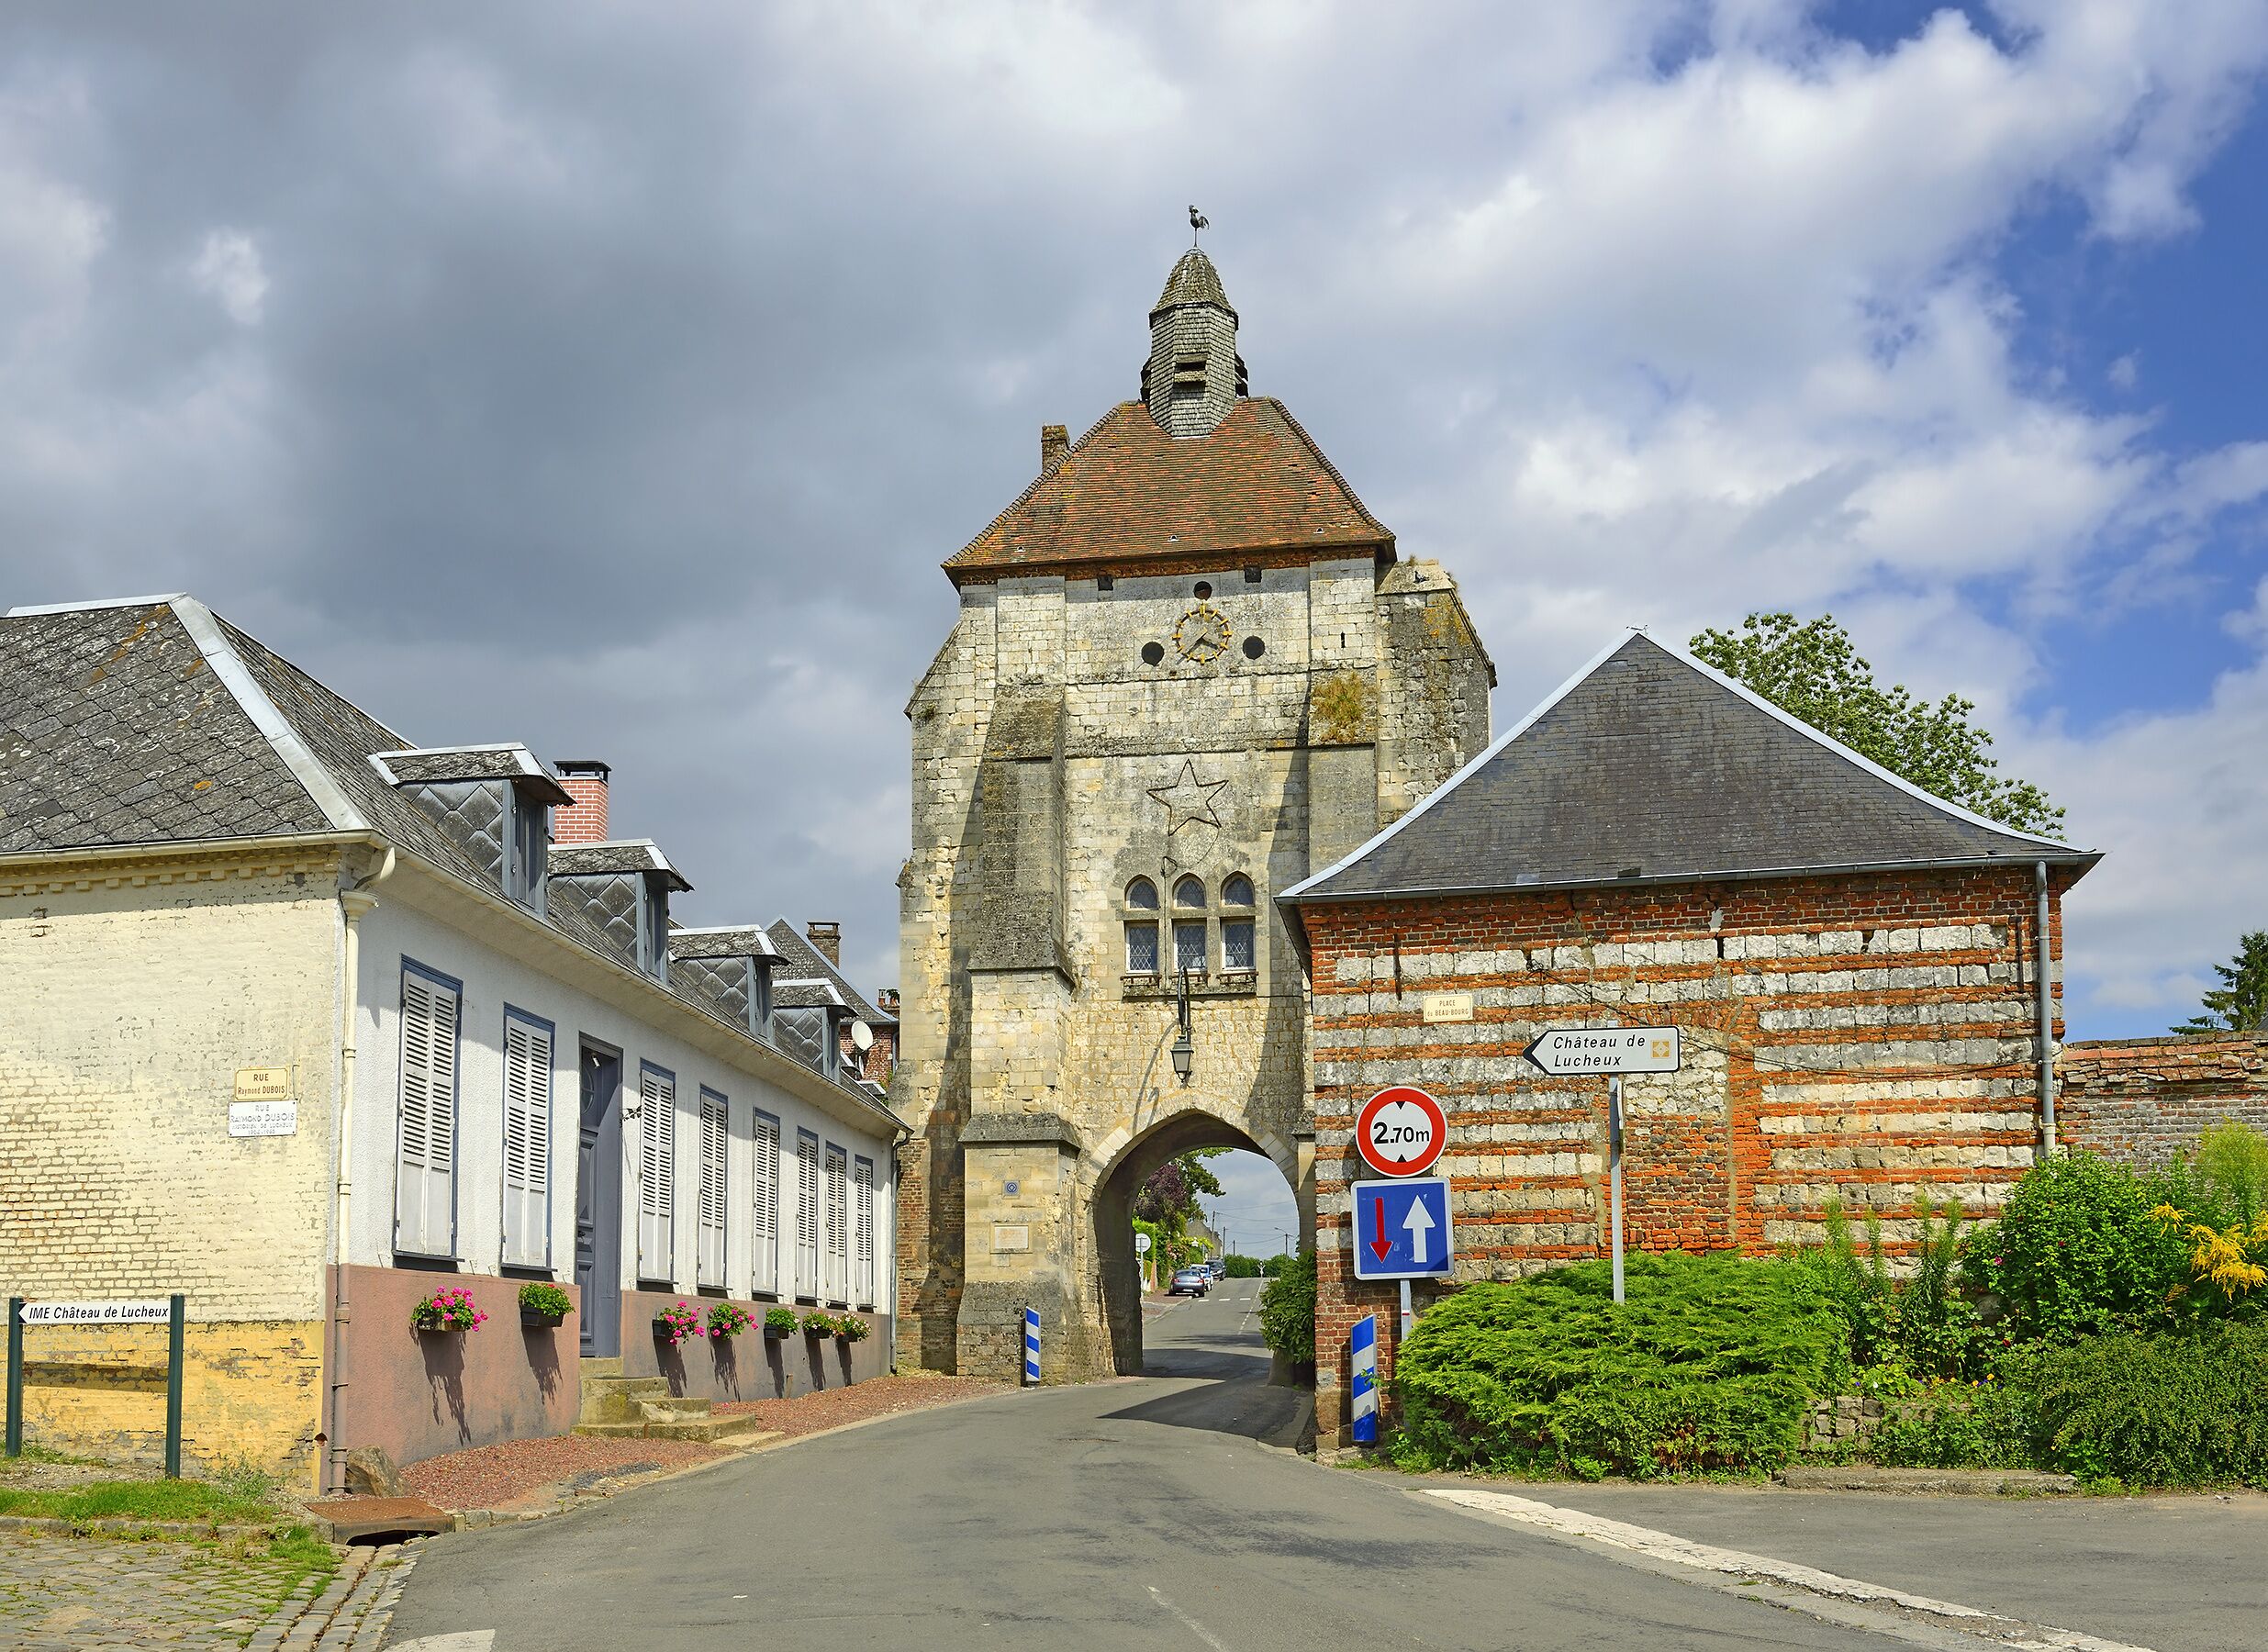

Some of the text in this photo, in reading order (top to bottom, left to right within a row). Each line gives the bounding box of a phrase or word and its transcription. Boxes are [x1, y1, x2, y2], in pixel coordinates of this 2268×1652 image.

[1435, 1008, 1469, 1016] BEAU-BOURG
[1553, 1033, 1646, 1049] Château de
[1554, 1054, 1622, 1067] Lucheux
[253, 1073, 269, 1082] RUE
[237, 1085, 285, 1097] Raymond DUBOIS
[255, 1104, 270, 1112] RUE
[264, 1112, 295, 1122] DUBOIS
[1373, 1122, 1430, 1144] 2.70m
[29, 1305, 169, 1319] IME Château de Lucheux
